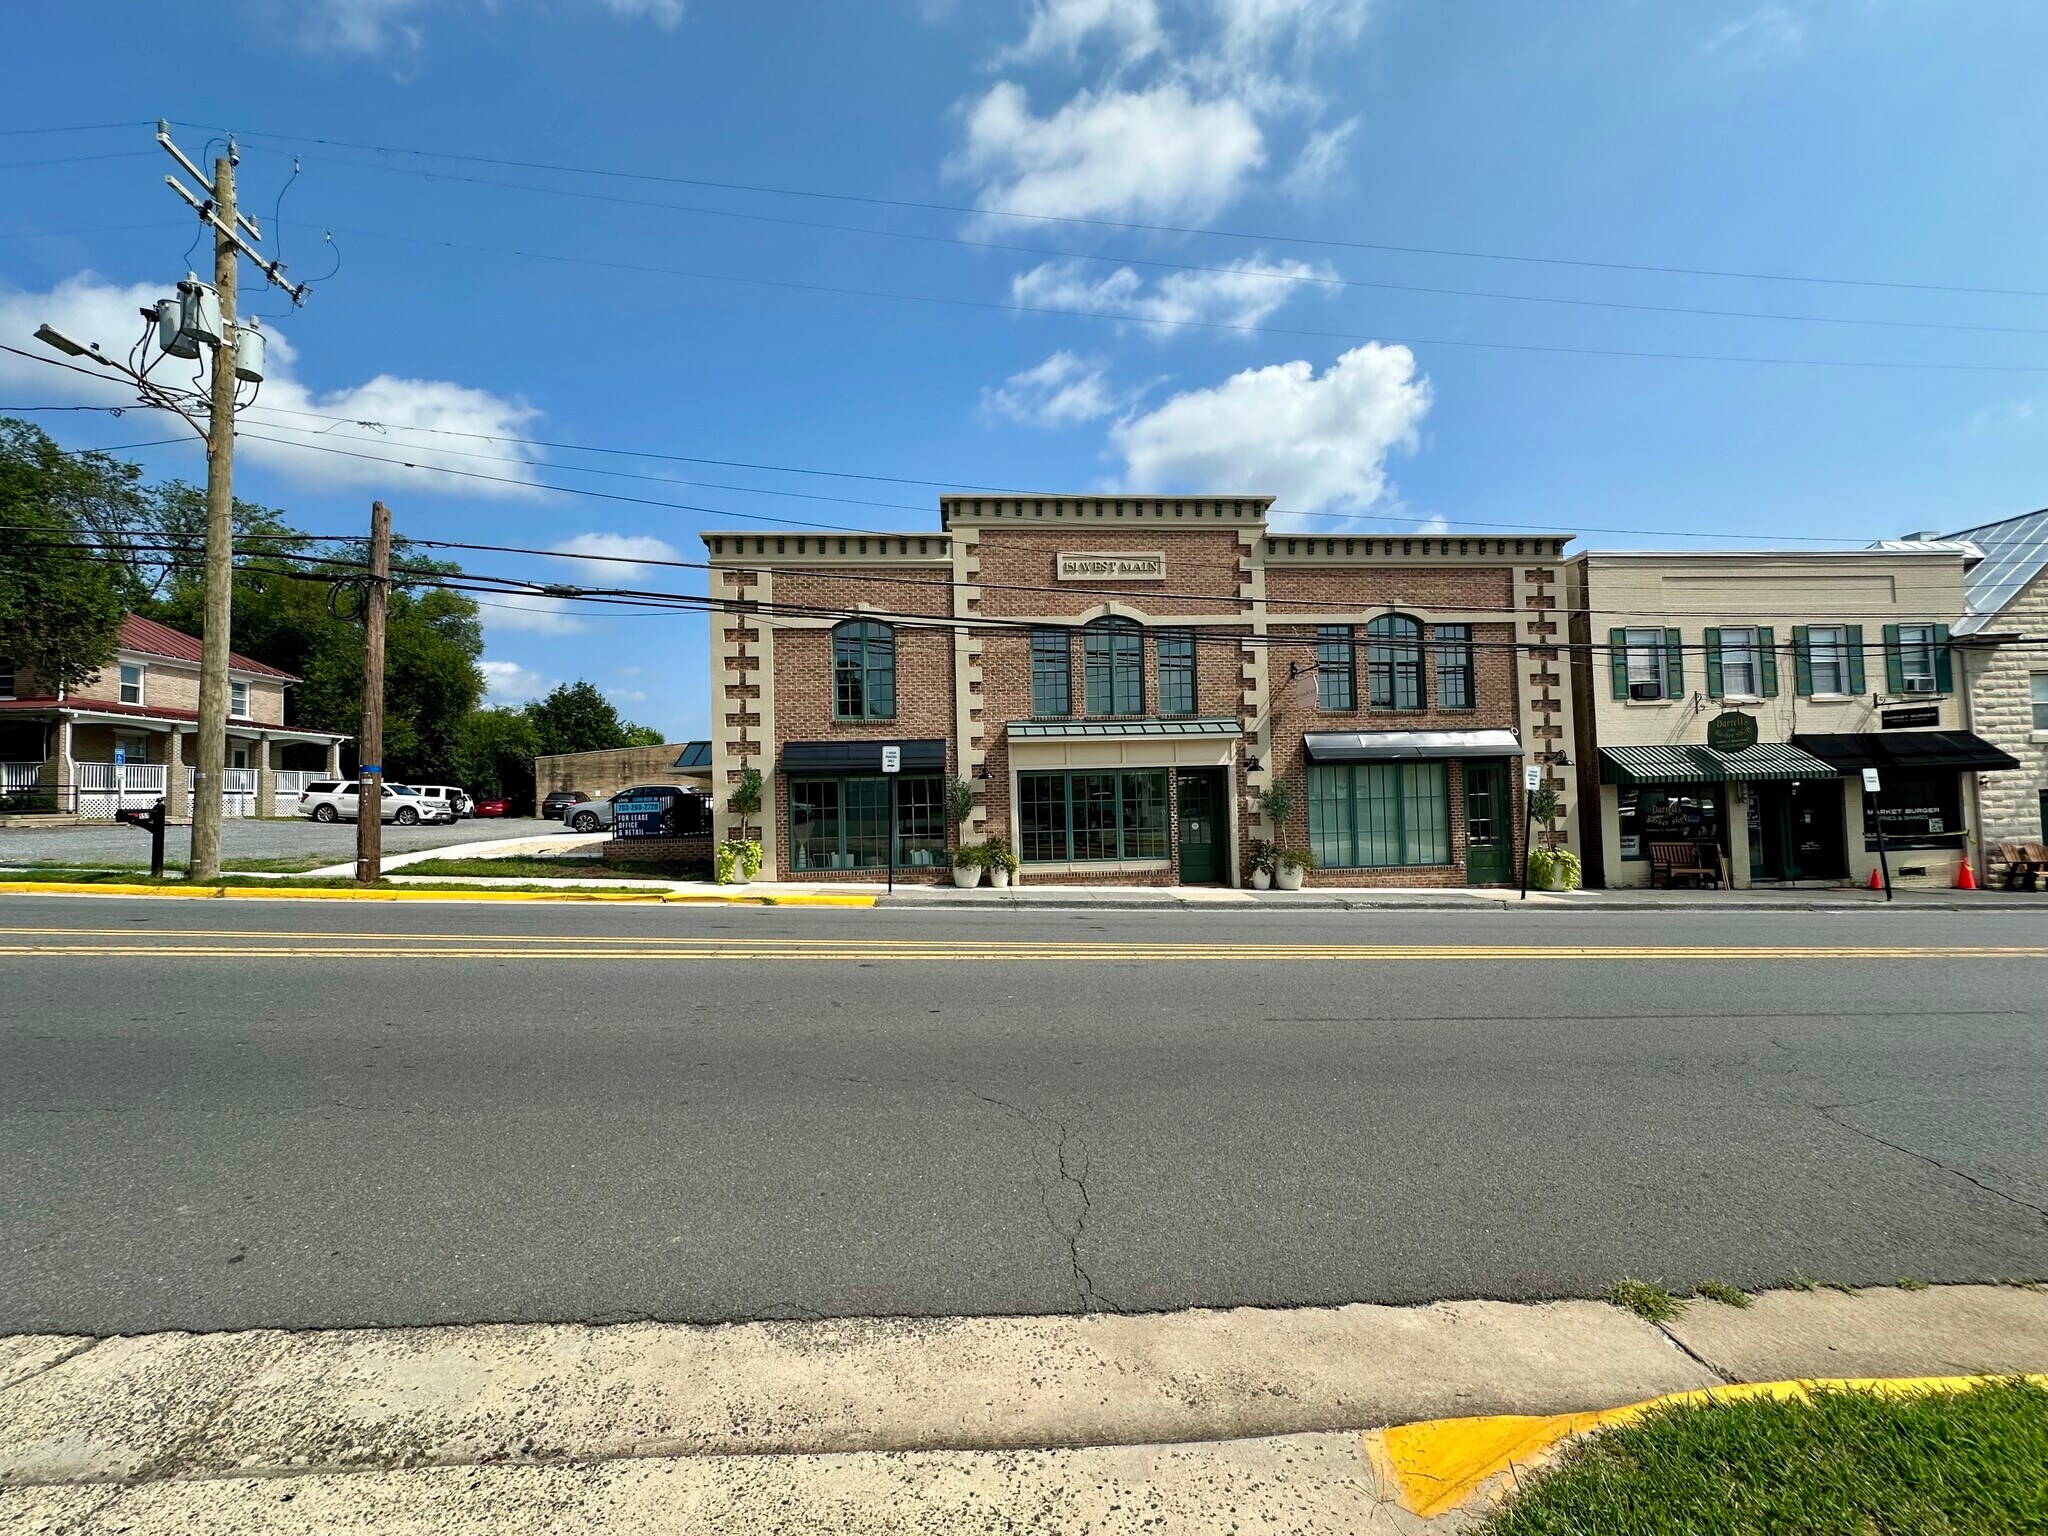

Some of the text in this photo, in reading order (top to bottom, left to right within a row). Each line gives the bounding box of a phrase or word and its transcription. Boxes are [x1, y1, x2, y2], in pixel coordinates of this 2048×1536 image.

[1063, 562, 1157, 572] 151 WEST MAIN
[1646, 815, 1670, 826] Barber
